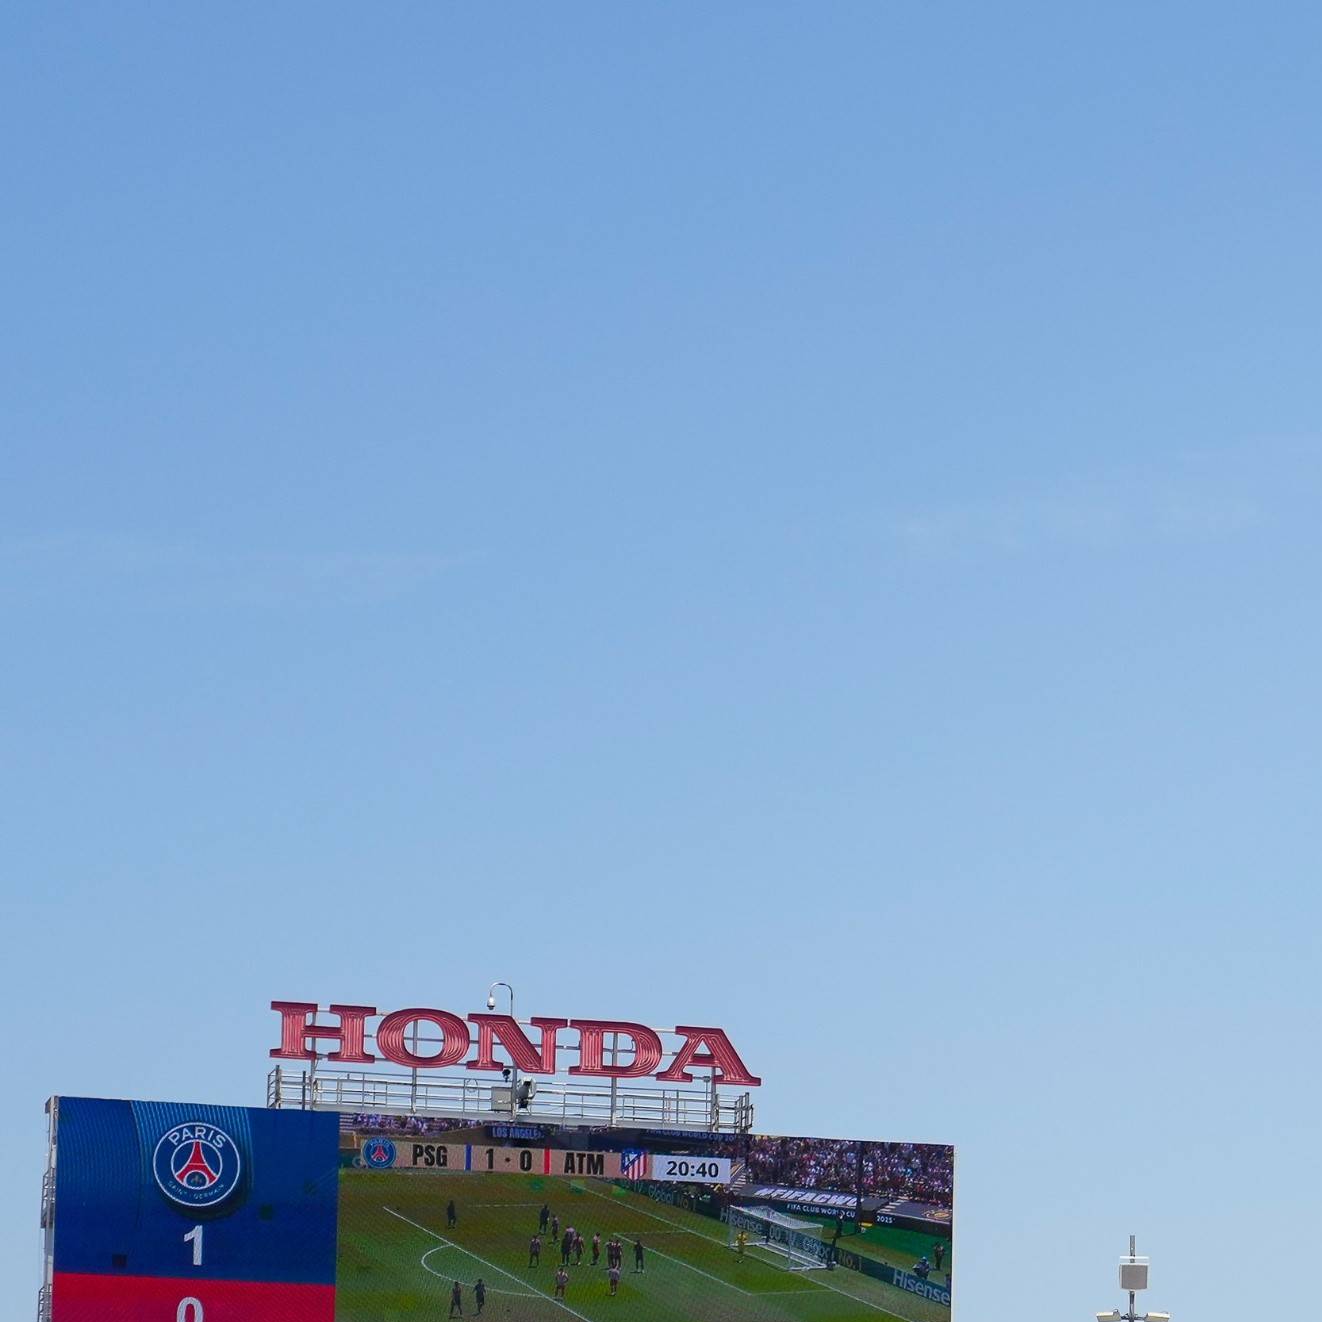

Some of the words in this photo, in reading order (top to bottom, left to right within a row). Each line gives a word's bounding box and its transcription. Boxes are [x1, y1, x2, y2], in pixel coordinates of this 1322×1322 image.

[270, 1001, 762, 1086] HONDA
[168, 1126, 226, 1148] PARIS
[412, 1144, 448, 1168] PSG
[485, 1149, 494, 1170] 1
[520, 1150, 532, 1172] 0
[564, 1152, 604, 1176] ATM
[666, 1160, 719, 1179] 20:40
[184, 1225, 203, 1266] 1
